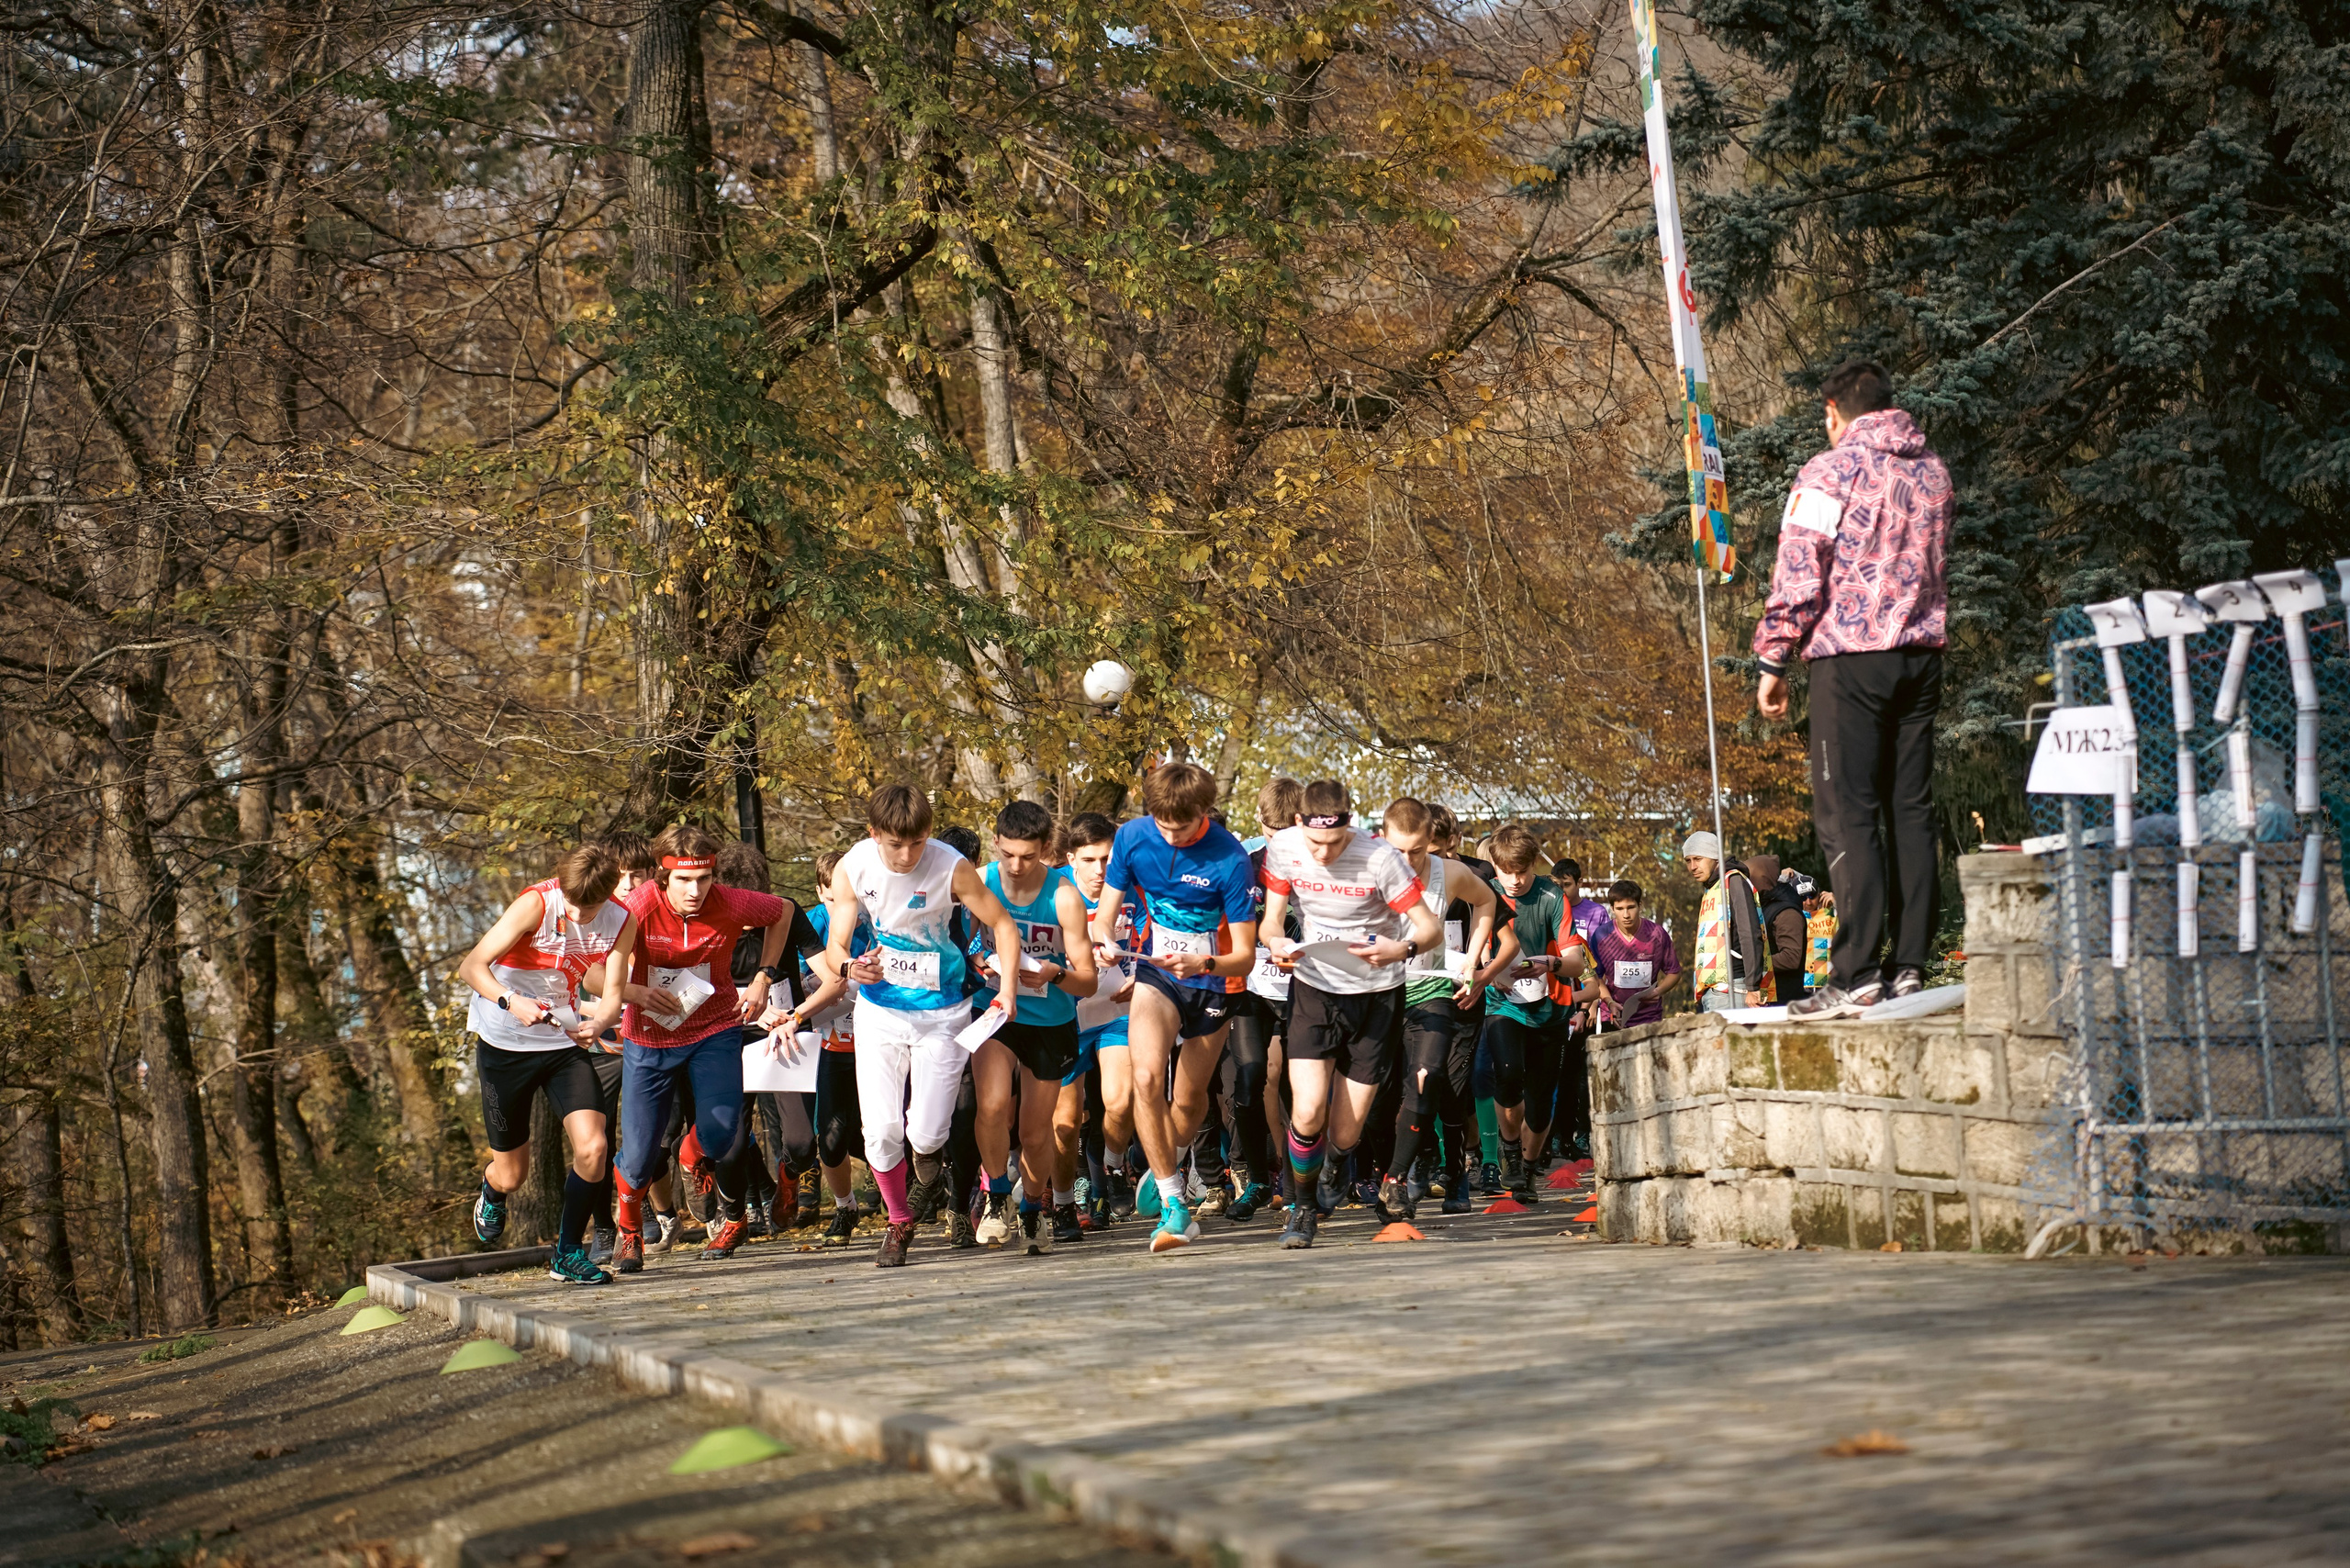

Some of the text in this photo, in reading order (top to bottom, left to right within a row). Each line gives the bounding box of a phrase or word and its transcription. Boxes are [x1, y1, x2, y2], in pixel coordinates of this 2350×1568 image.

[2223, 590, 2241, 605] 3
[2107, 611, 2121, 628] 1
[677, 858, 711, 867] noname
[1291, 879, 1376, 897] ORD WEST
[1164, 936, 1188, 952] 202
[890, 958, 917, 973] 204
[1622, 968, 1640, 976] 255
